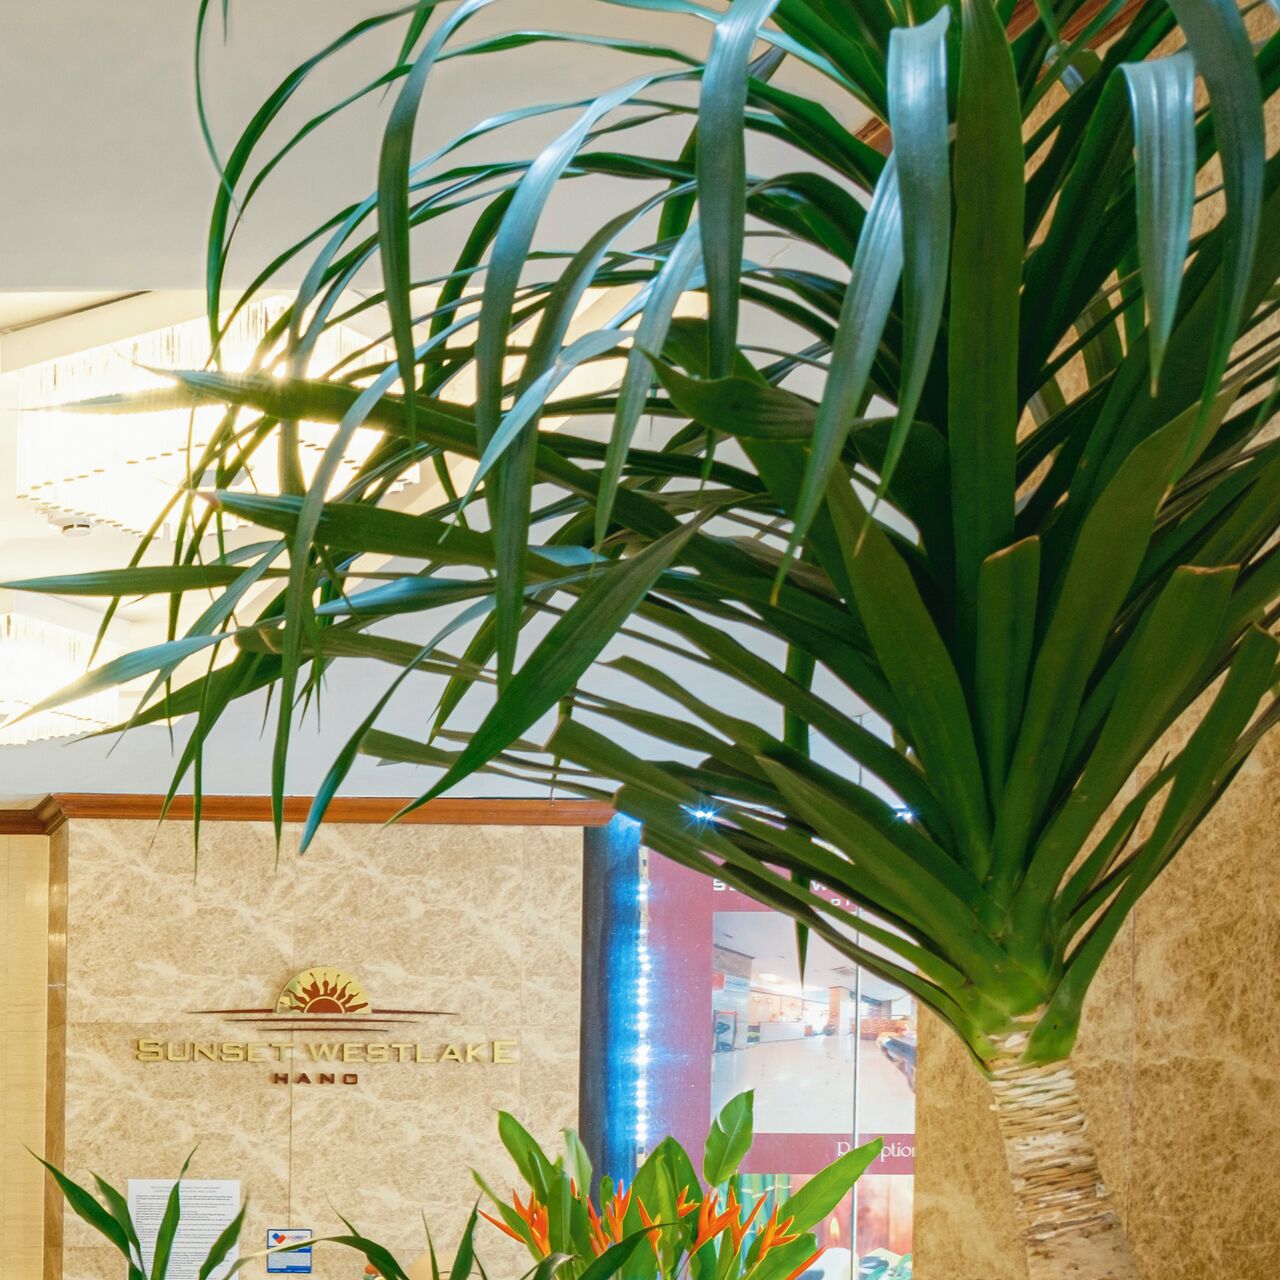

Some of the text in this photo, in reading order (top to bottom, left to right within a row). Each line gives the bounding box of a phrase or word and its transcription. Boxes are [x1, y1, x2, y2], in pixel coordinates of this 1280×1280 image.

[136, 1037, 519, 1065] SUNSET WESTLAKE
[272, 1072, 359, 1086] HANO
